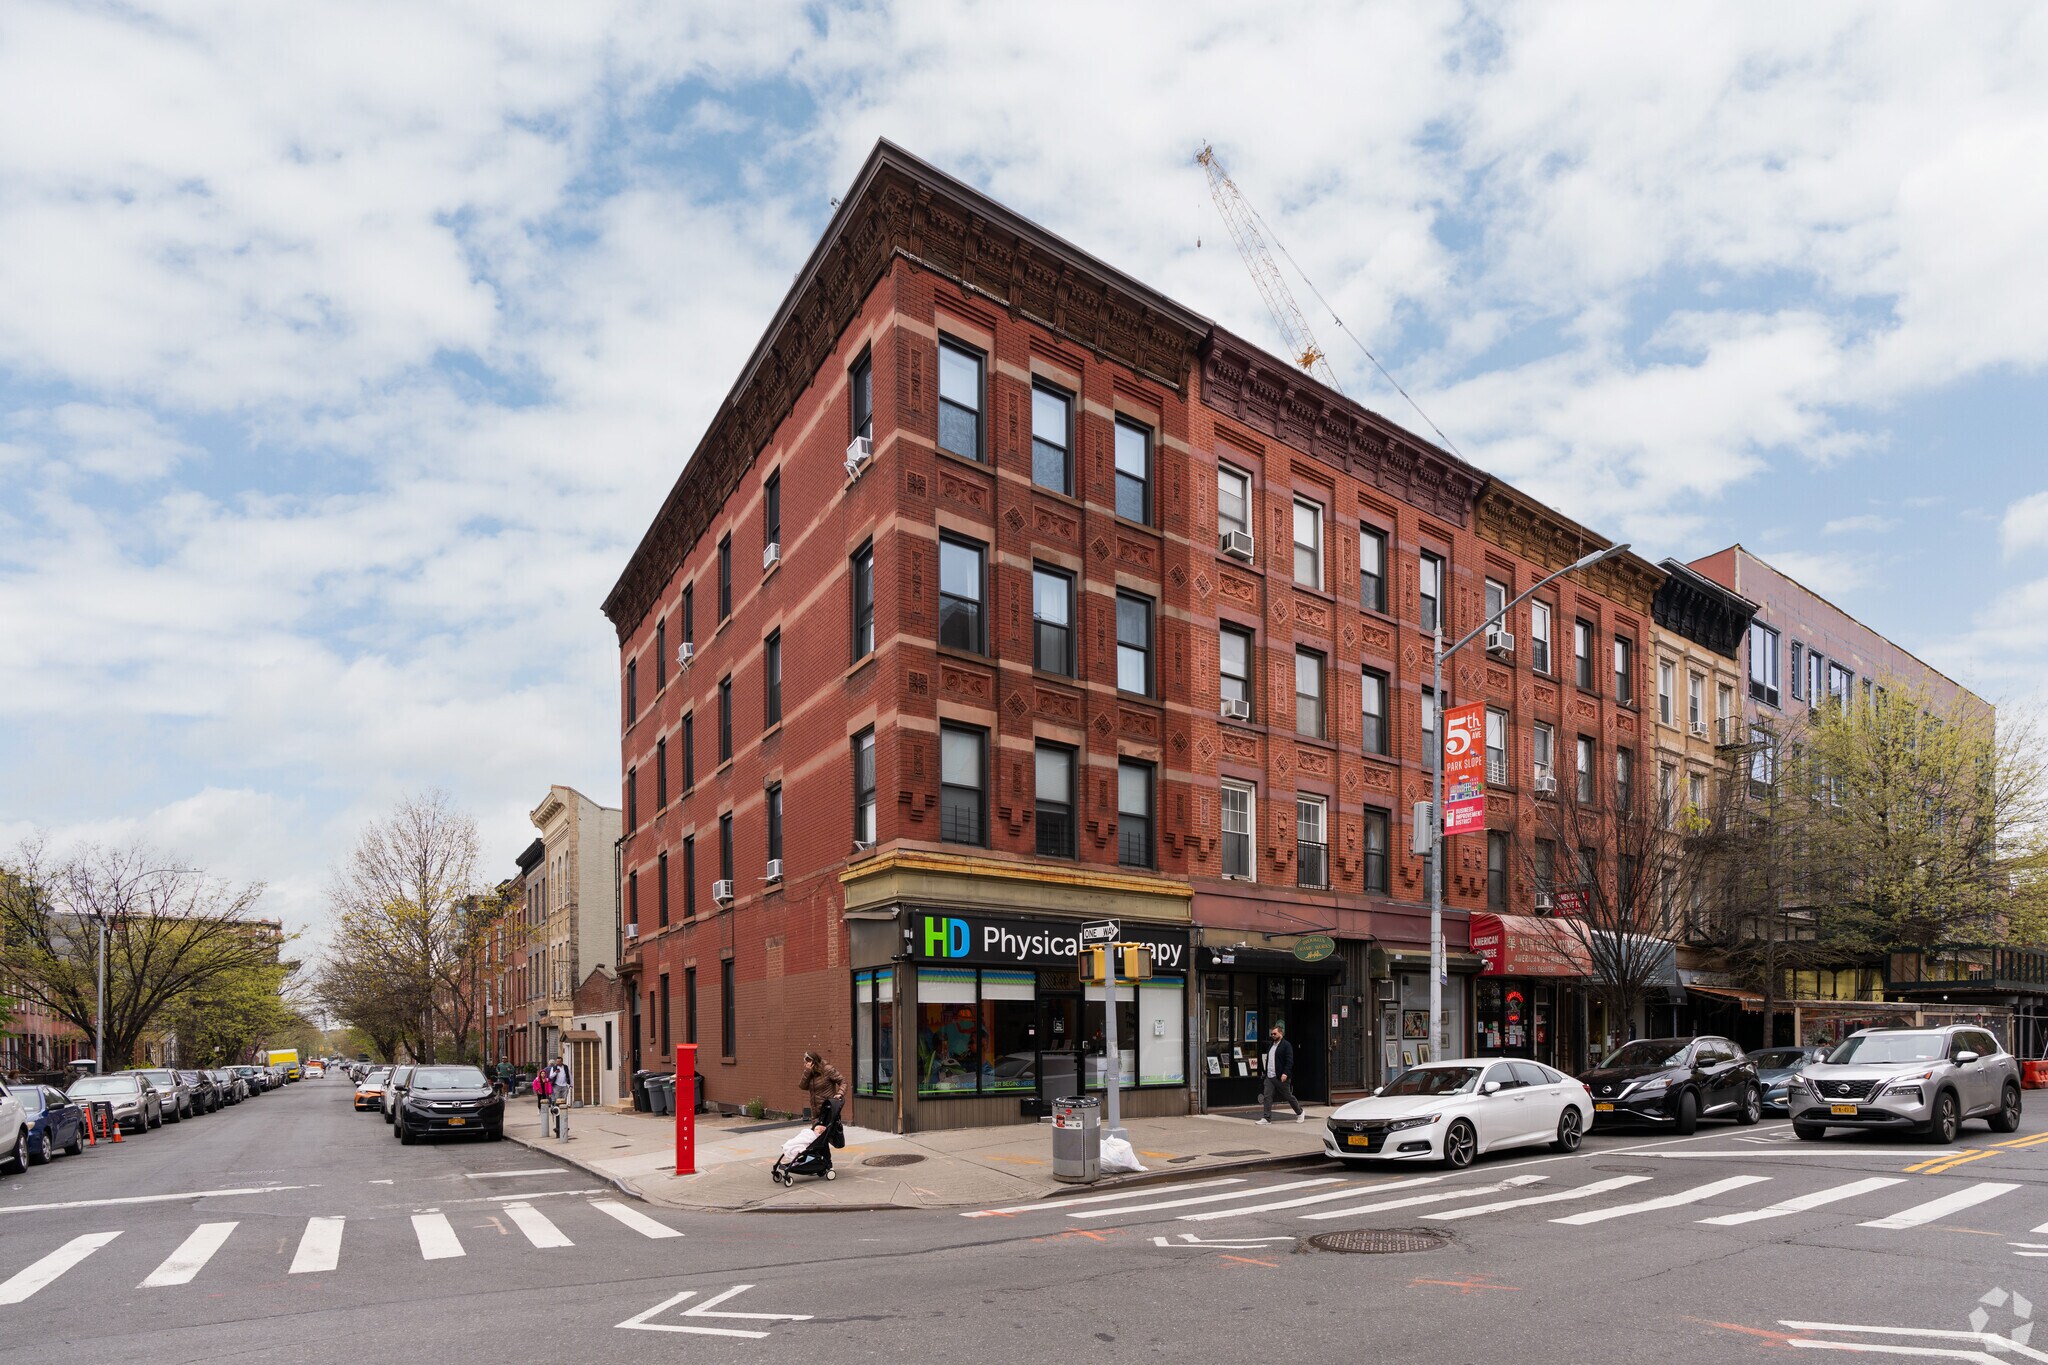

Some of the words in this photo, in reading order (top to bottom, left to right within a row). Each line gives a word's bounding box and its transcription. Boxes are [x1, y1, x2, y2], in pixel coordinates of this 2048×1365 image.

[1446, 712, 1482, 756] 5th
[1471, 731, 1482, 740] AVE
[1447, 761, 1462, 772] PARK
[1464, 756, 1482, 769] SLOPE
[1456, 806, 1473, 815] BUSINESS
[1456, 811, 1482, 820] IMPROVEMENT
[1084, 928, 1098, 938] ONE
[1102, 926, 1116, 937] WAY
[924, 916, 971, 958] HD
[983, 925, 1084, 961] Physical
[1474, 936, 1498, 946] AMERICAN
[1514, 954, 1541, 963] AMERICAN
